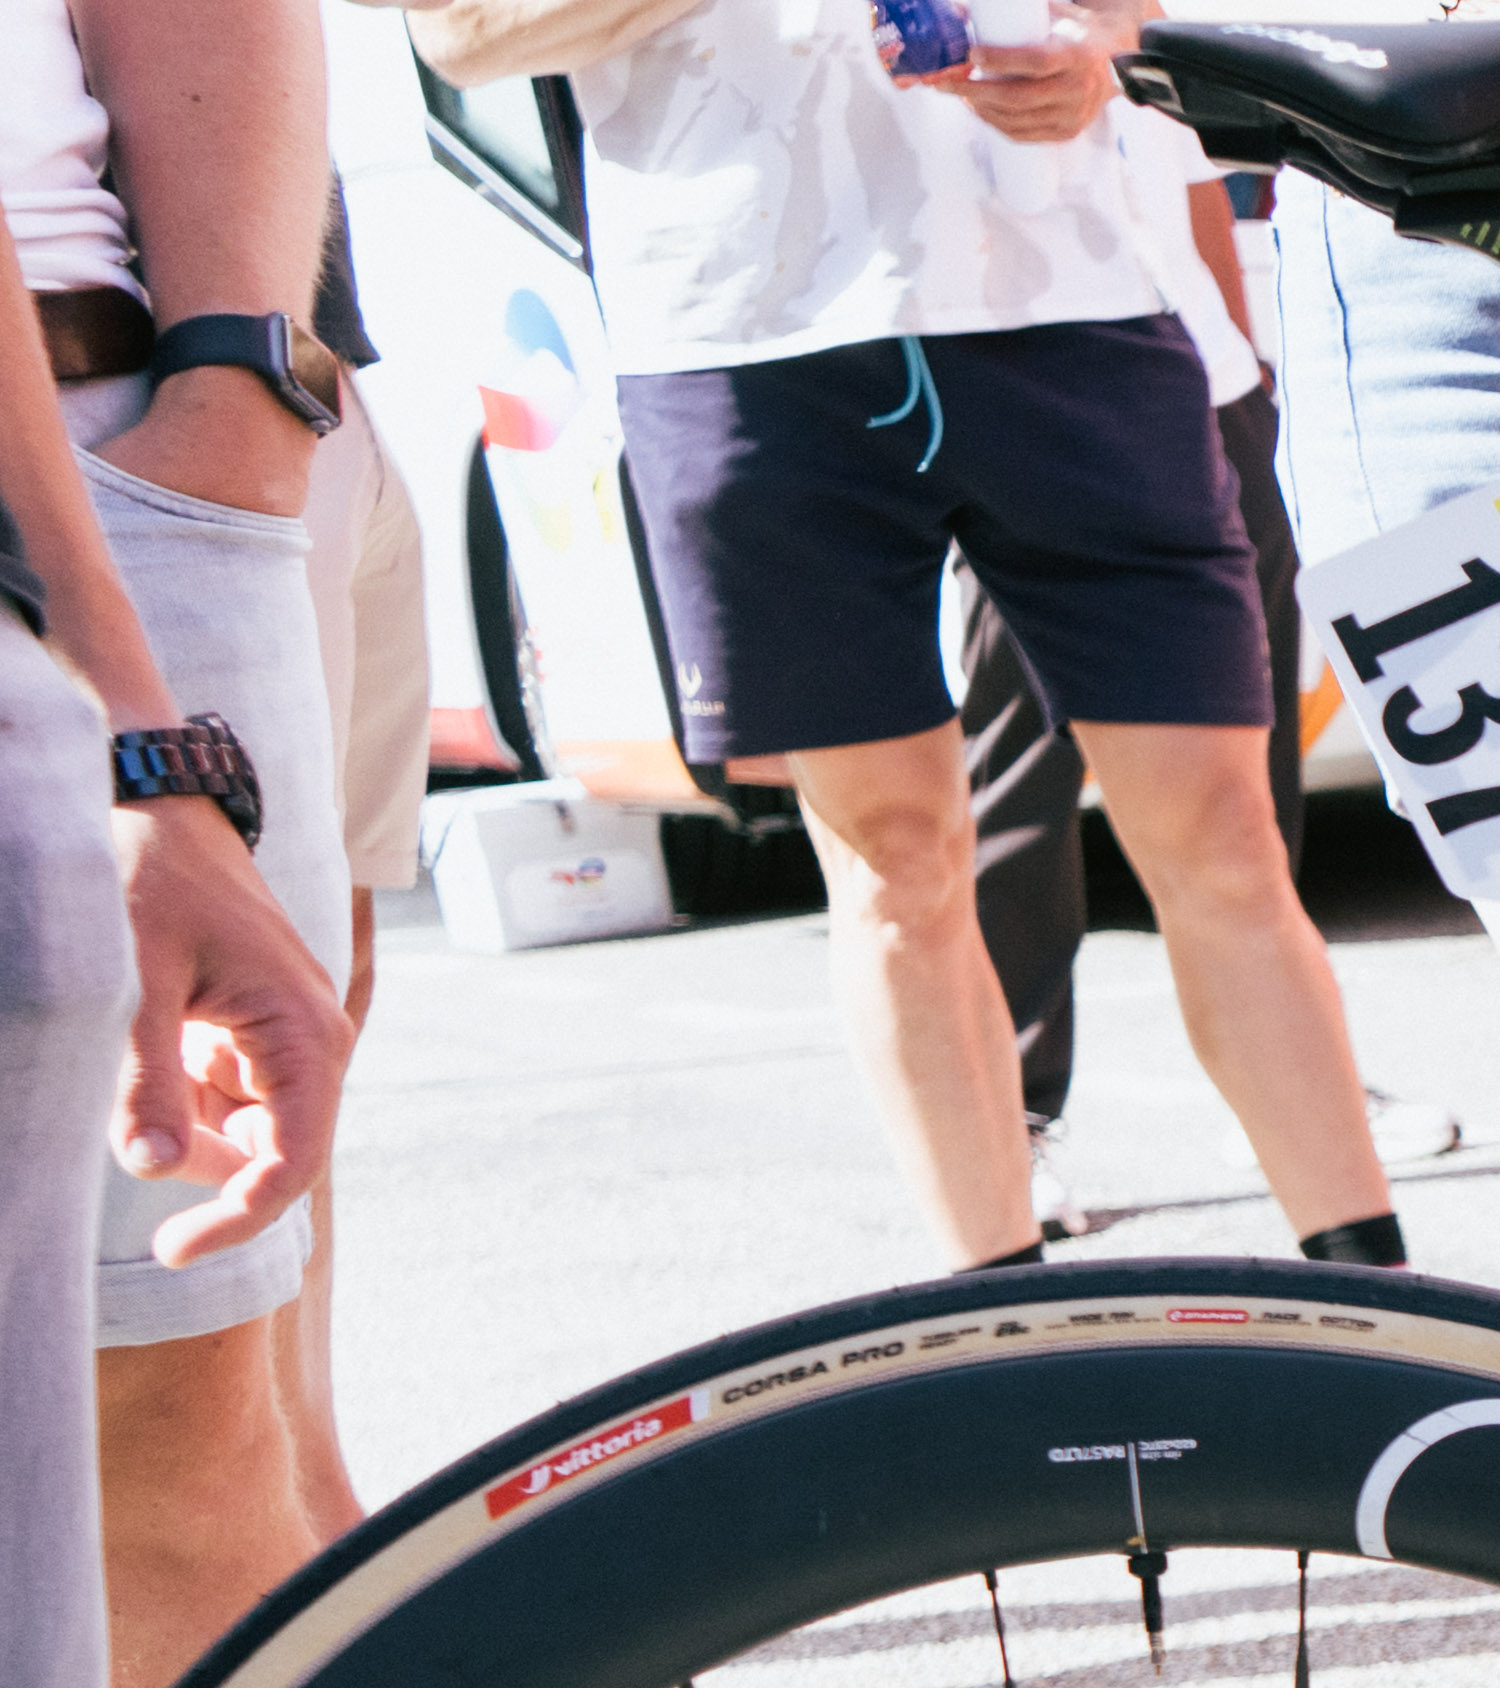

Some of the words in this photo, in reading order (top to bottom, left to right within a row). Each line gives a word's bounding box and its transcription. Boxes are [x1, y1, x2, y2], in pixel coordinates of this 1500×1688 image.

[720, 1359, 831, 1405] CORSA
[840, 1340, 906, 1369] PRO
[554, 1418, 663, 1477] vittoria
